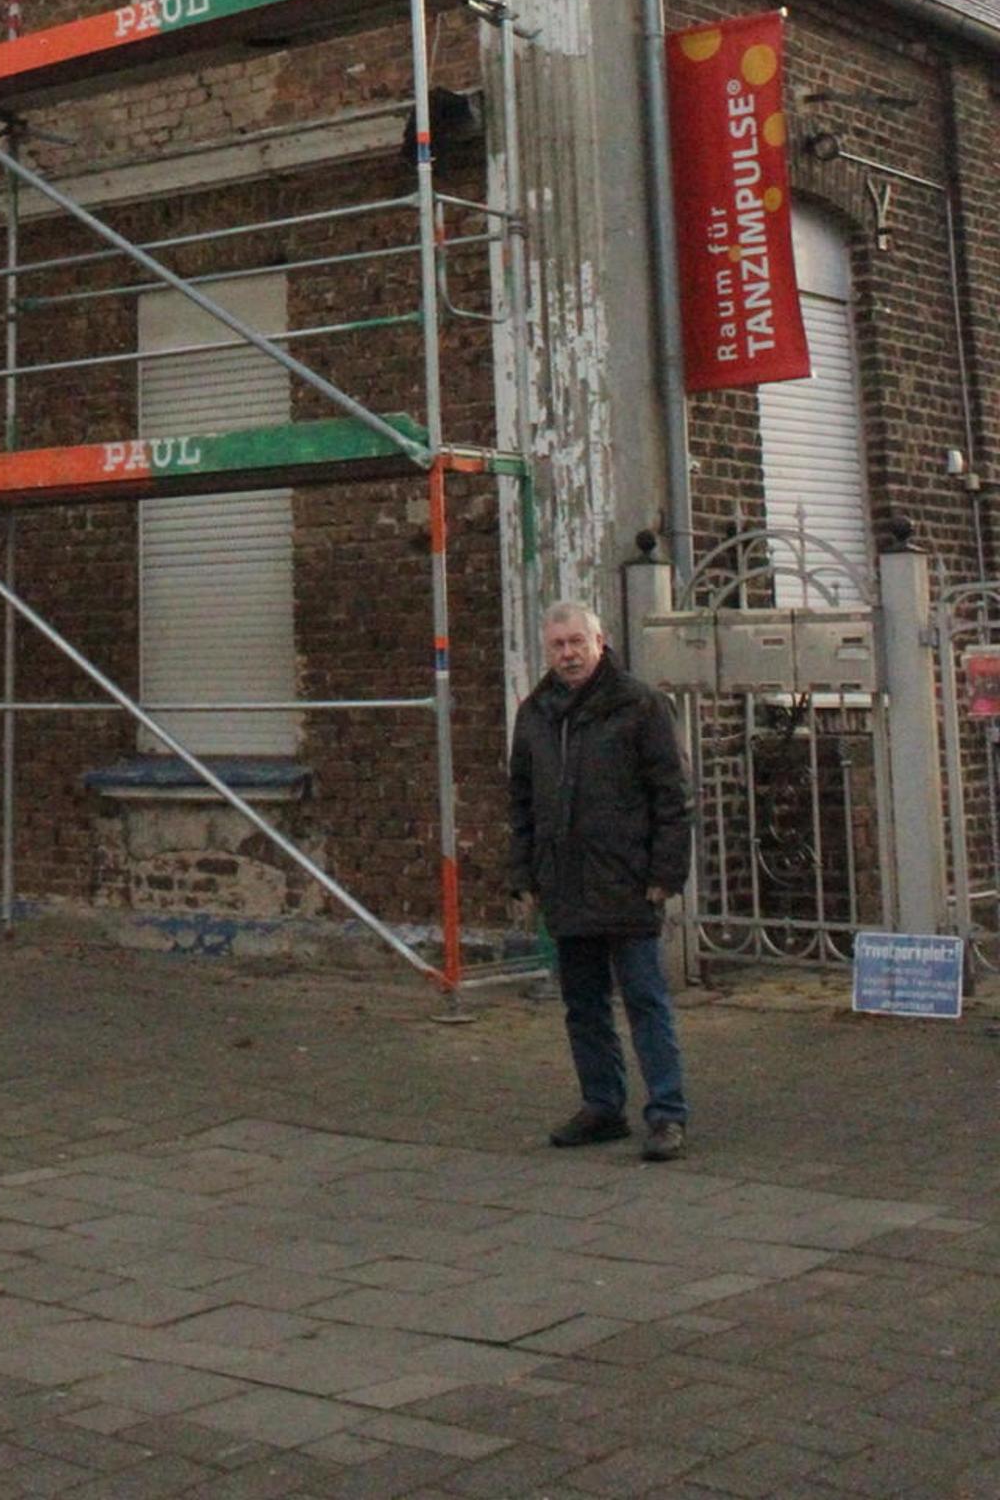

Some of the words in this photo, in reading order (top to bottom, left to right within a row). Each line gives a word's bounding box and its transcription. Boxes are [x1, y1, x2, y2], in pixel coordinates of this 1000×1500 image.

[708, 206, 729, 254] für
[716, 270, 738, 361] Raum
[103, 436, 201, 470] PAUL
